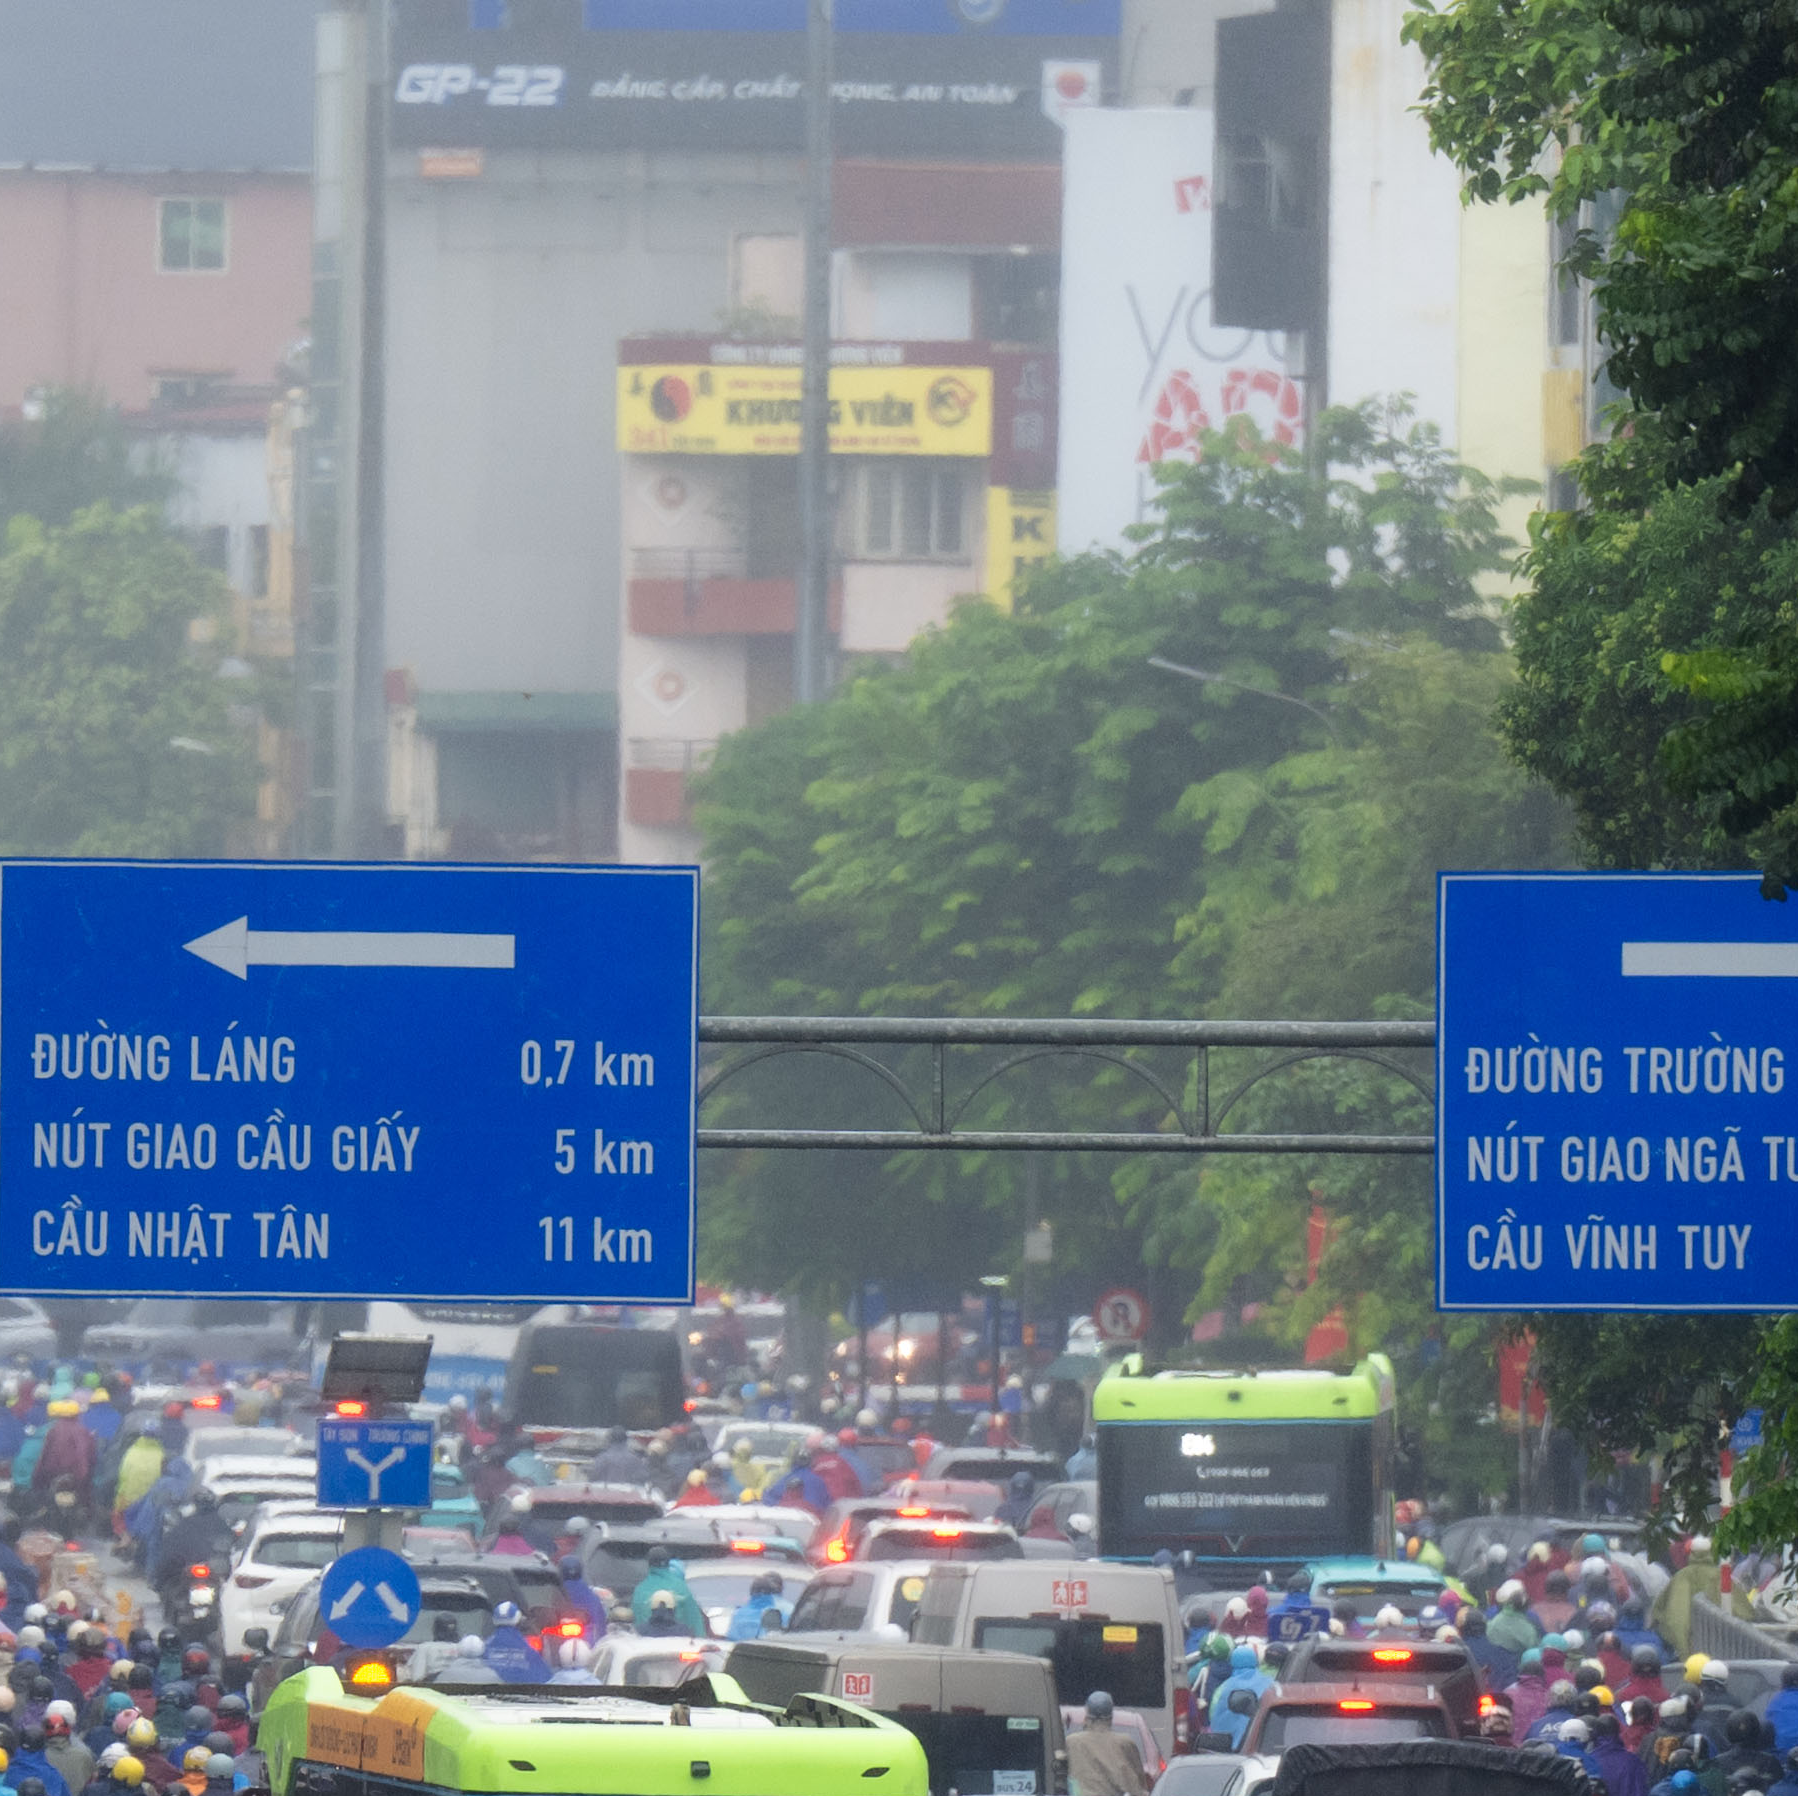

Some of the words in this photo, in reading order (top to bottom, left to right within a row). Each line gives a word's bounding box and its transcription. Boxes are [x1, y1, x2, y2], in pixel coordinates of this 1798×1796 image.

[395, 62, 565, 107] GP-22
[31, 1020, 170, 1081] ĐƯỜNG
[191, 1021, 295, 1082] LÁNG
[521, 1040, 574, 1087] 0,7
[595, 1041, 653, 1086] km
[1465, 1033, 1602, 1093] ĐƯỜNG
[1624, 1032, 1783, 1093] TRƯỜNG
[35, 1108, 110, 1168] NÚT
[128, 1123, 216, 1169] GIAO
[238, 1109, 310, 1170] CẦU
[333, 1111, 419, 1171] GIẤY
[555, 1129, 575, 1174] 5
[595, 1129, 653, 1174] km
[1469, 1121, 1544, 1182] NÚT
[1562, 1137, 1649, 1182] GIAO
[1666, 1127, 1744, 1182] NGÃ
[34, 1195, 108, 1256] CẦU
[129, 1204, 231, 1264] NHẬT
[253, 1205, 328, 1258] TÂN
[539, 1217, 572, 1261] 11
[594, 1217, 652, 1262] km
[1468, 1208, 1542, 1270] CẦU
[1565, 1215, 1656, 1269] VĨNH
[1678, 1225, 1751, 1269] TUY
